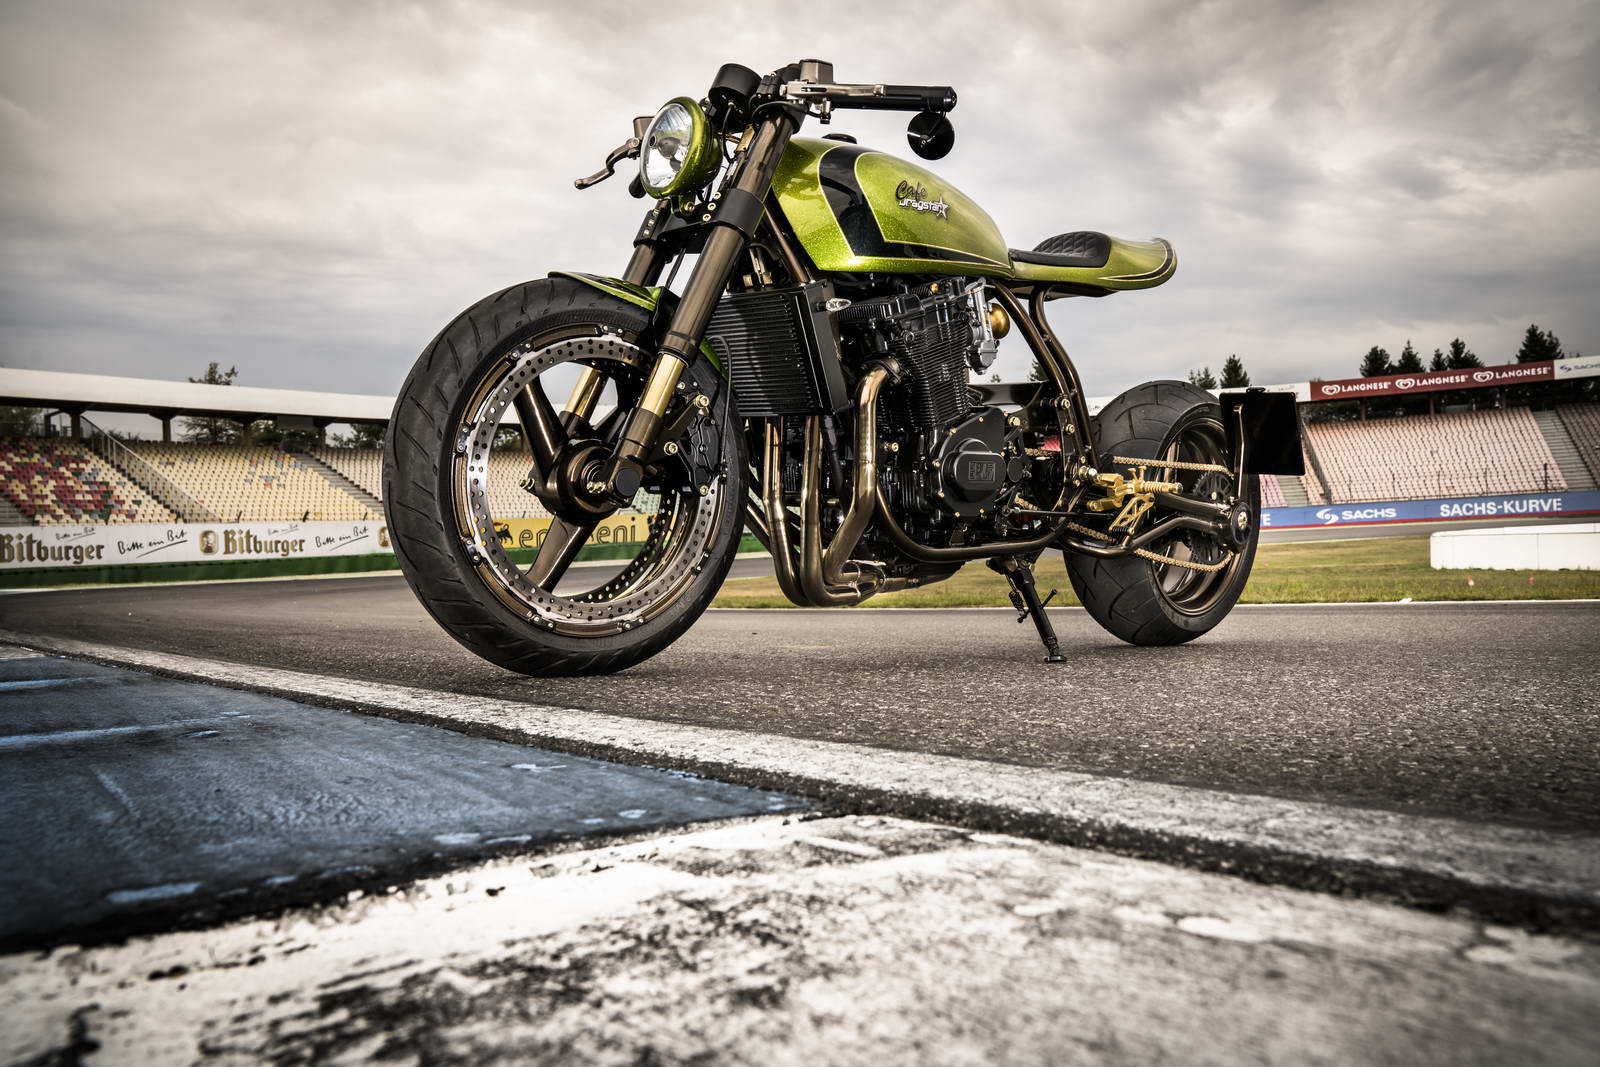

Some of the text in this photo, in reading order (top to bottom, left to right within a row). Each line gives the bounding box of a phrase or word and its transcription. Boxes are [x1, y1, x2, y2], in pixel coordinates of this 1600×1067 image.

[1416, 375, 1467, 387] LANGNESE
[1495, 367, 1549, 379] LANGNESE
[1341, 381, 1390, 393] LANGNESE
[1341, 508, 1397, 520] SACHS
[1440, 498, 1563, 517] SACHS-KURVE
[518, 529, 548, 549] en
[596, 516, 636, 544] eni
[0, 533, 105, 565] Bitburger
[117, 540, 145, 555] Bitte
[166, 529, 187, 542] Bit
[223, 528, 306, 557] Bitburger
